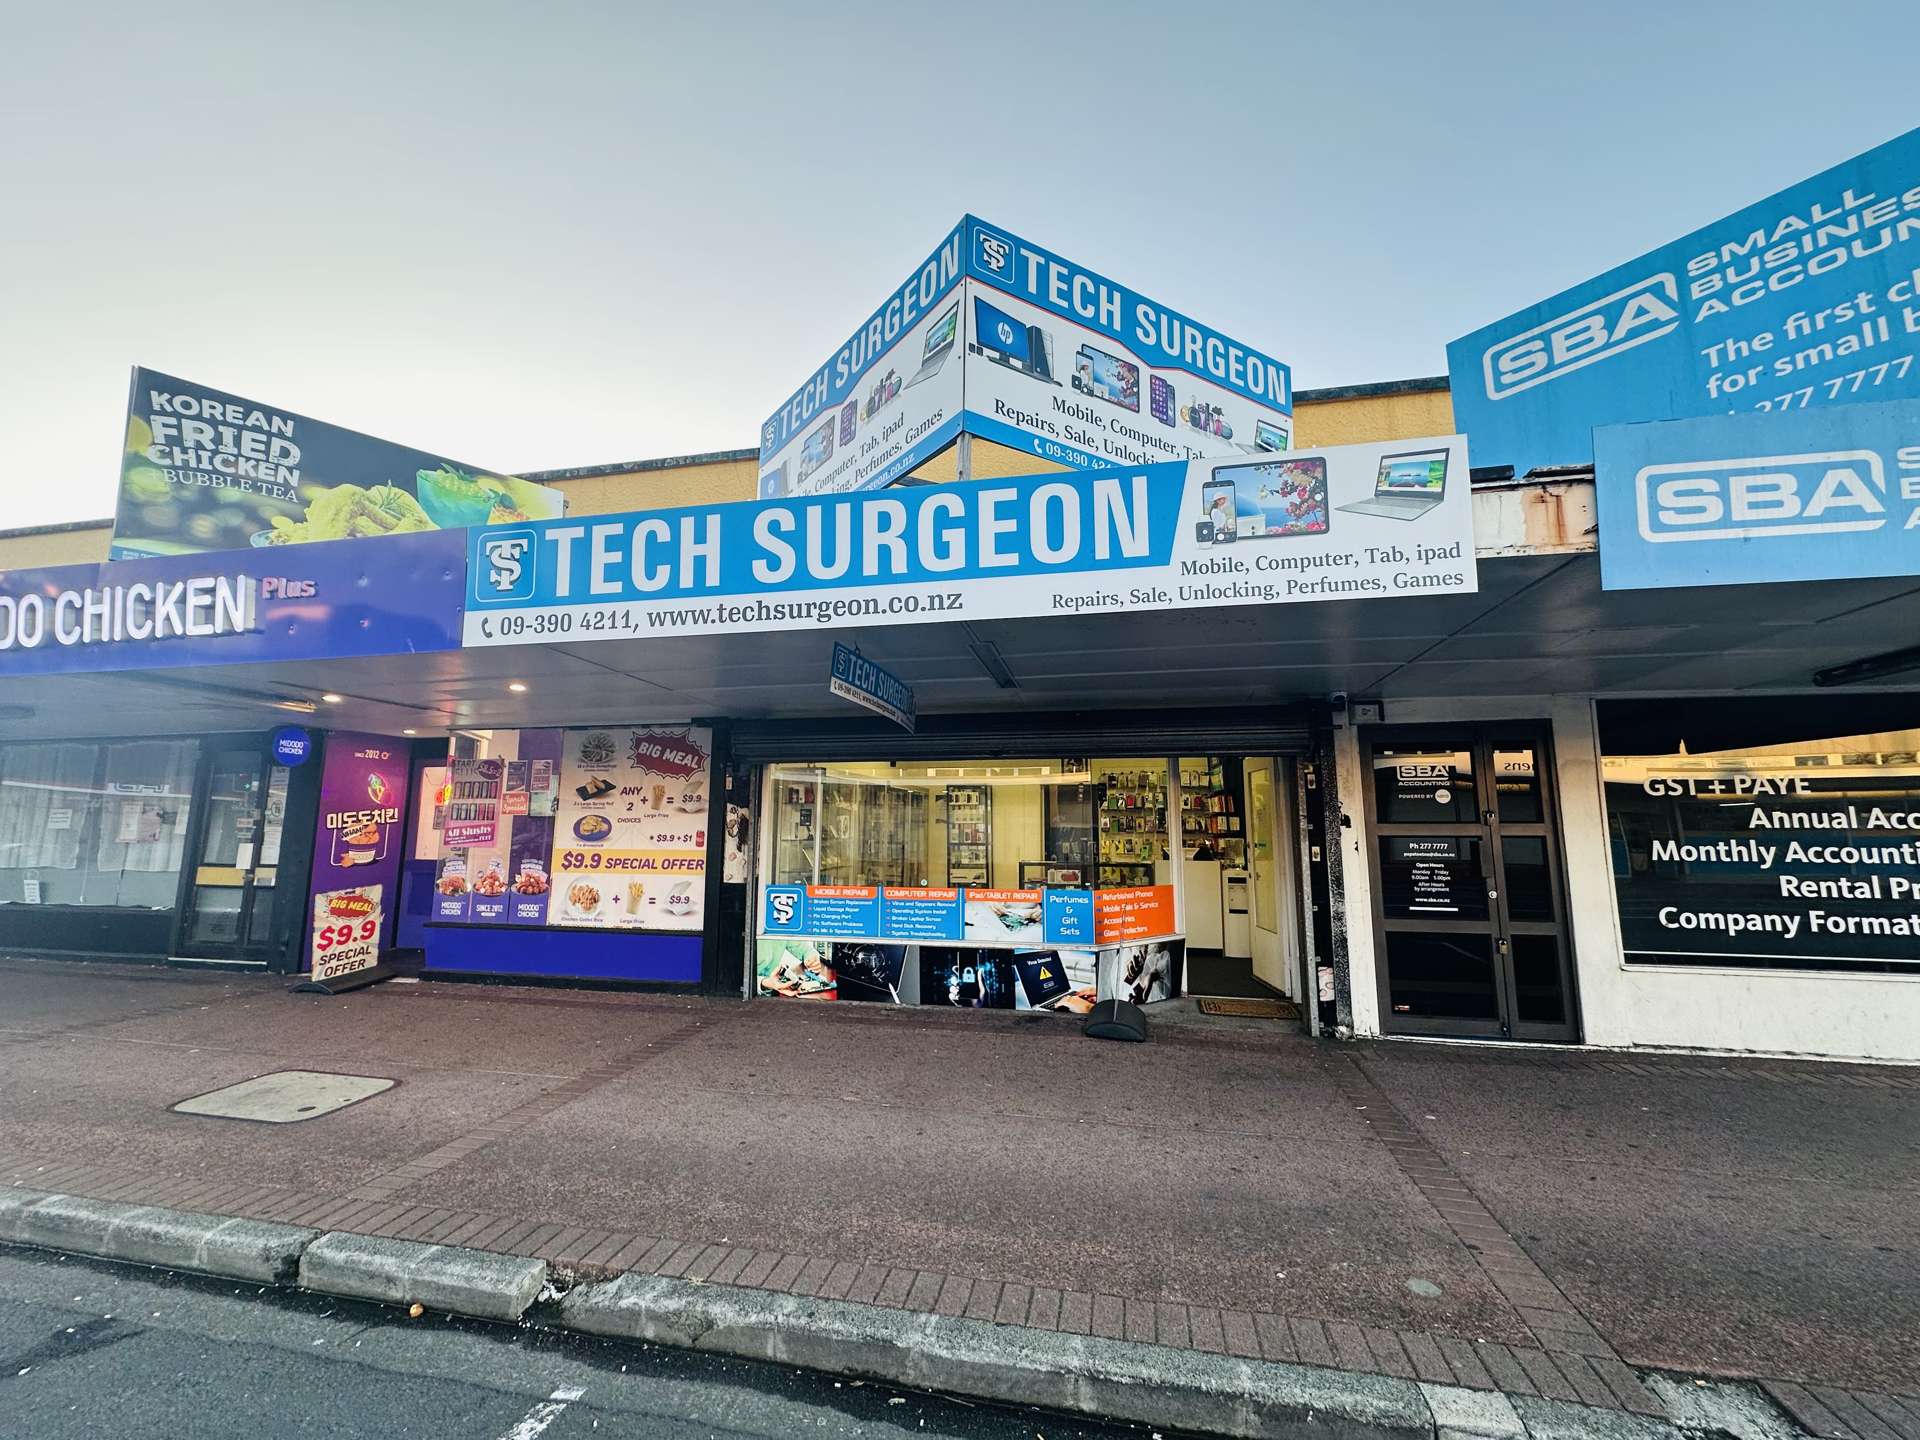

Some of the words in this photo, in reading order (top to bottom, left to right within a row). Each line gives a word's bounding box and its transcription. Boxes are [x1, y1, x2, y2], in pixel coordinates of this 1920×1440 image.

[1686, 188, 1876, 277] SMALL
[780, 368, 829, 440] TECH
[835, 233, 959, 389] SURGEON
[1020, 247, 1121, 332] TECH
[1136, 303, 1286, 405] SURGEON
[1498, 292, 1680, 385] SBA
[1701, 332, 1774, 368] The
[1783, 290, 1876, 341] first
[1706, 366, 1764, 399] for
[1773, 316, 1889, 377] small
[1823, 354, 1914, 399] 7777
[150, 390, 294, 437] KOREAN
[994, 398, 1060, 438] Repairs,
[1064, 425, 1099, 452] Sale,
[1052, 395, 1106, 431] Mobile,
[1110, 418, 1180, 458] Computer,
[150, 415, 301, 467] FRIED
[855, 441, 902, 483] Perfumes,
[905, 407, 943, 445] Games
[859, 436, 881, 457] Tab,
[882, 412, 904, 442] ipad
[146, 445, 301, 487] CHICKEN
[1046, 442, 1088, 468] 09-390
[257, 481, 299, 503] TEA
[1656, 468, 1886, 526] SBA
[545, 513, 721, 597] TECH
[752, 475, 1150, 584] SURGEON
[1180, 544, 1250, 578] Mobile,
[1255, 550, 1359, 574] Computer,
[1364, 544, 1410, 566] Tab,
[1416, 541, 1461, 562] ipad
[1052, 588, 1125, 611] Repairs,
[1129, 586, 1174, 606] Sale,
[1178, 579, 1280, 602] Unlocking,
[1286, 574, 1387, 596] Perfumes,
[1393, 571, 1464, 590] Games
[54, 574, 246, 646] CHICKEN
[261, 576, 317, 599] Plus
[500, 612, 573, 638] 09-390
[579, 609, 640, 634] 4211,
[647, 592, 963, 629] www.techsurgeon.co.nz
[848, 655, 877, 693] TECH
[365, 749, 379, 759] 2012
[637, 741, 660, 758] BIG
[662, 747, 699, 769] MEAL
[1400, 766, 1449, 777] SBA
[620, 786, 643, 797] ANY
[682, 794, 702, 803] $9.9
[1643, 777, 1698, 797] GST
[1734, 775, 1811, 796] PAYE
[326, 806, 398, 829] 미도도치킨
[626, 803, 634, 811] 2
[1748, 806, 1858, 830] Annual
[656, 834, 675, 843] $9.9
[683, 834, 692, 843] $1
[561, 850, 602, 871] $9.9
[604, 857, 658, 870] SPECIAL
[661, 858, 705, 871] OFFER
[1651, 839, 1777, 869] Monthly
[669, 895, 690, 905] $9.9
[815, 888, 841, 896] MOBILE
[842, 888, 868, 896] REPAIR
[886, 889, 926, 898] COMPUTER
[928, 890, 956, 898] REPAIR
[1013, 891, 1038, 899] REPAIR
[1050, 895, 1089, 904] Perfumes
[1779, 874, 1882, 900] Rental
[331, 899, 347, 909] BIG
[348, 900, 373, 912] MEAL
[1065, 906, 1073, 914] &
[1103, 904, 1121, 913] Mobile
[1060, 927, 1080, 936] Sets
[1062, 916, 1079, 925] Gift
[1658, 907, 1801, 940] Company
[316, 920, 376, 951] $9.9
[318, 945, 372, 967] SPECIAL
[324, 958, 366, 978] OFFER
